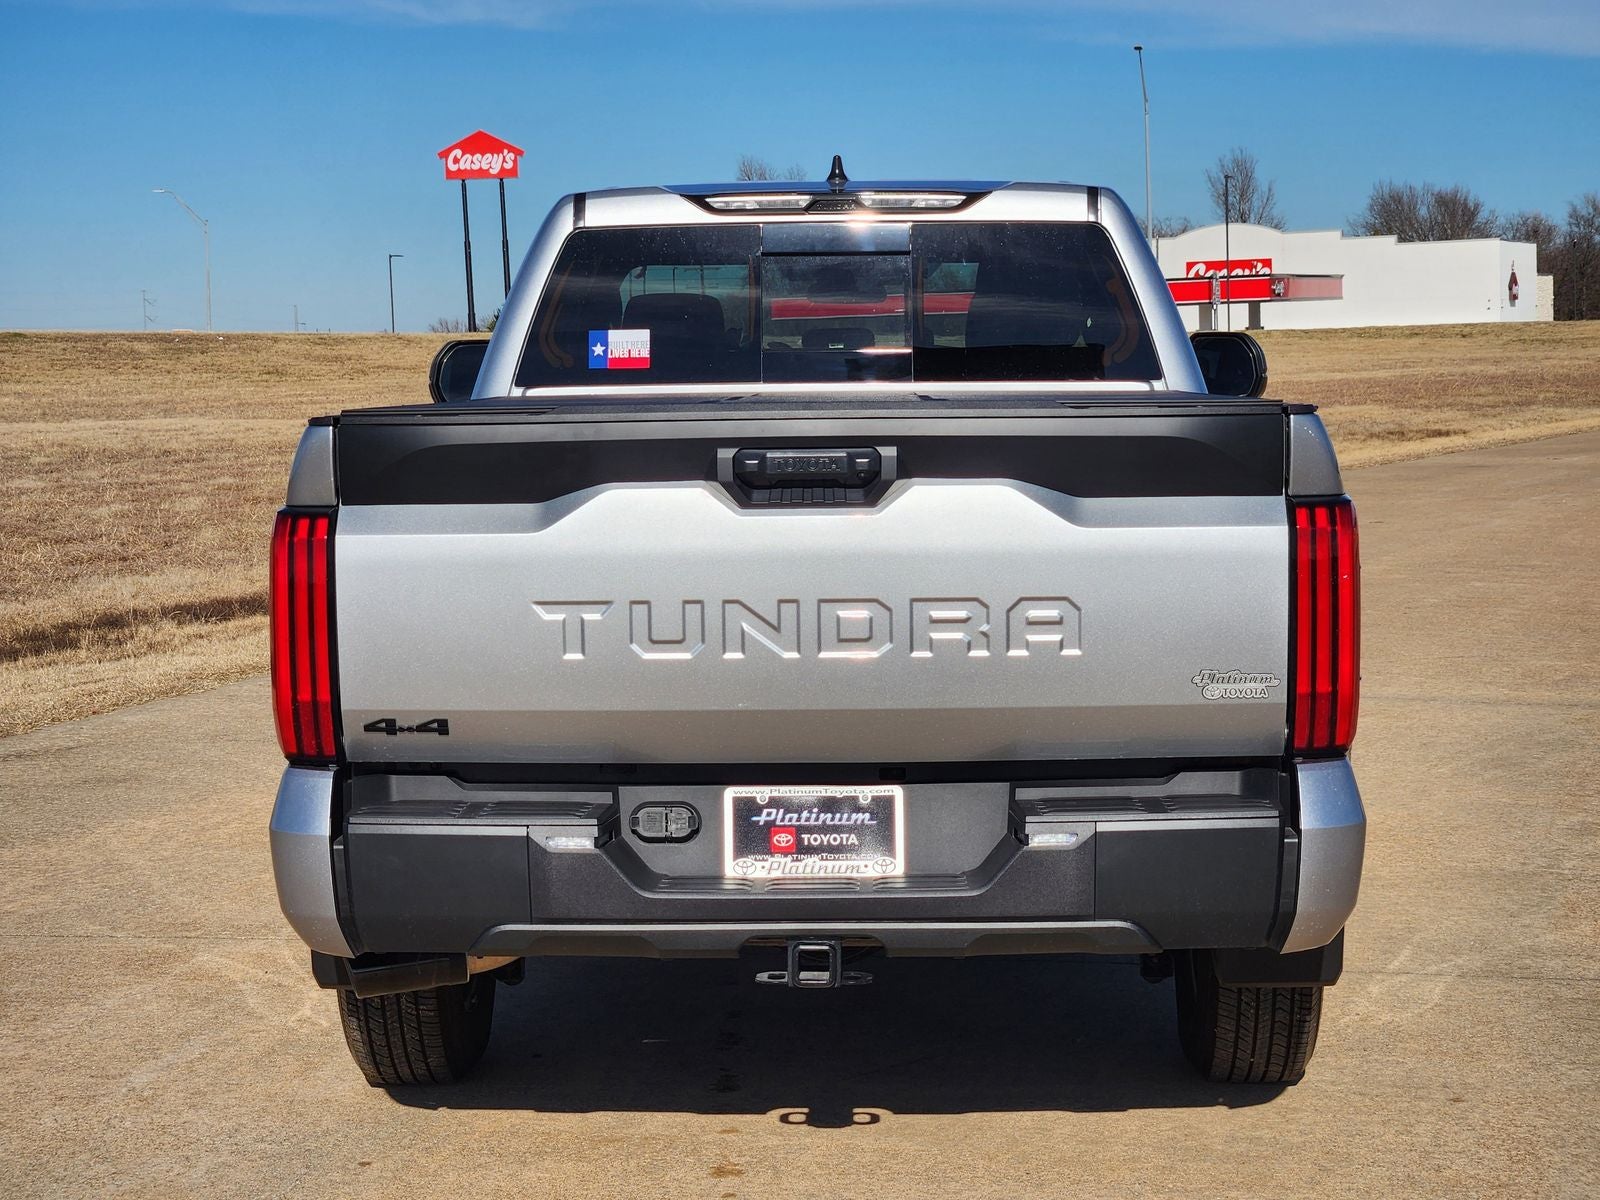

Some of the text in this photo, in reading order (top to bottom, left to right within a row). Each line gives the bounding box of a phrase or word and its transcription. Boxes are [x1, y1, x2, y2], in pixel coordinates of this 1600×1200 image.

[447, 149, 515, 175] Casey's
[630, 340, 649, 348] HERE
[608, 348, 650, 358] LIVES HERE
[773, 458, 841, 472] TOYOTA
[530, 597, 1083, 661] TUNDRA
[1192, 669, 1281, 687] Platinum
[1223, 688, 1268, 697] TOYOTA
[733, 787, 894, 796] www.PlatinumToyota.com
[751, 808, 877, 825] Platinum
[802, 834, 859, 846] TOYOTA
[766, 859, 866, 875] Platinum
